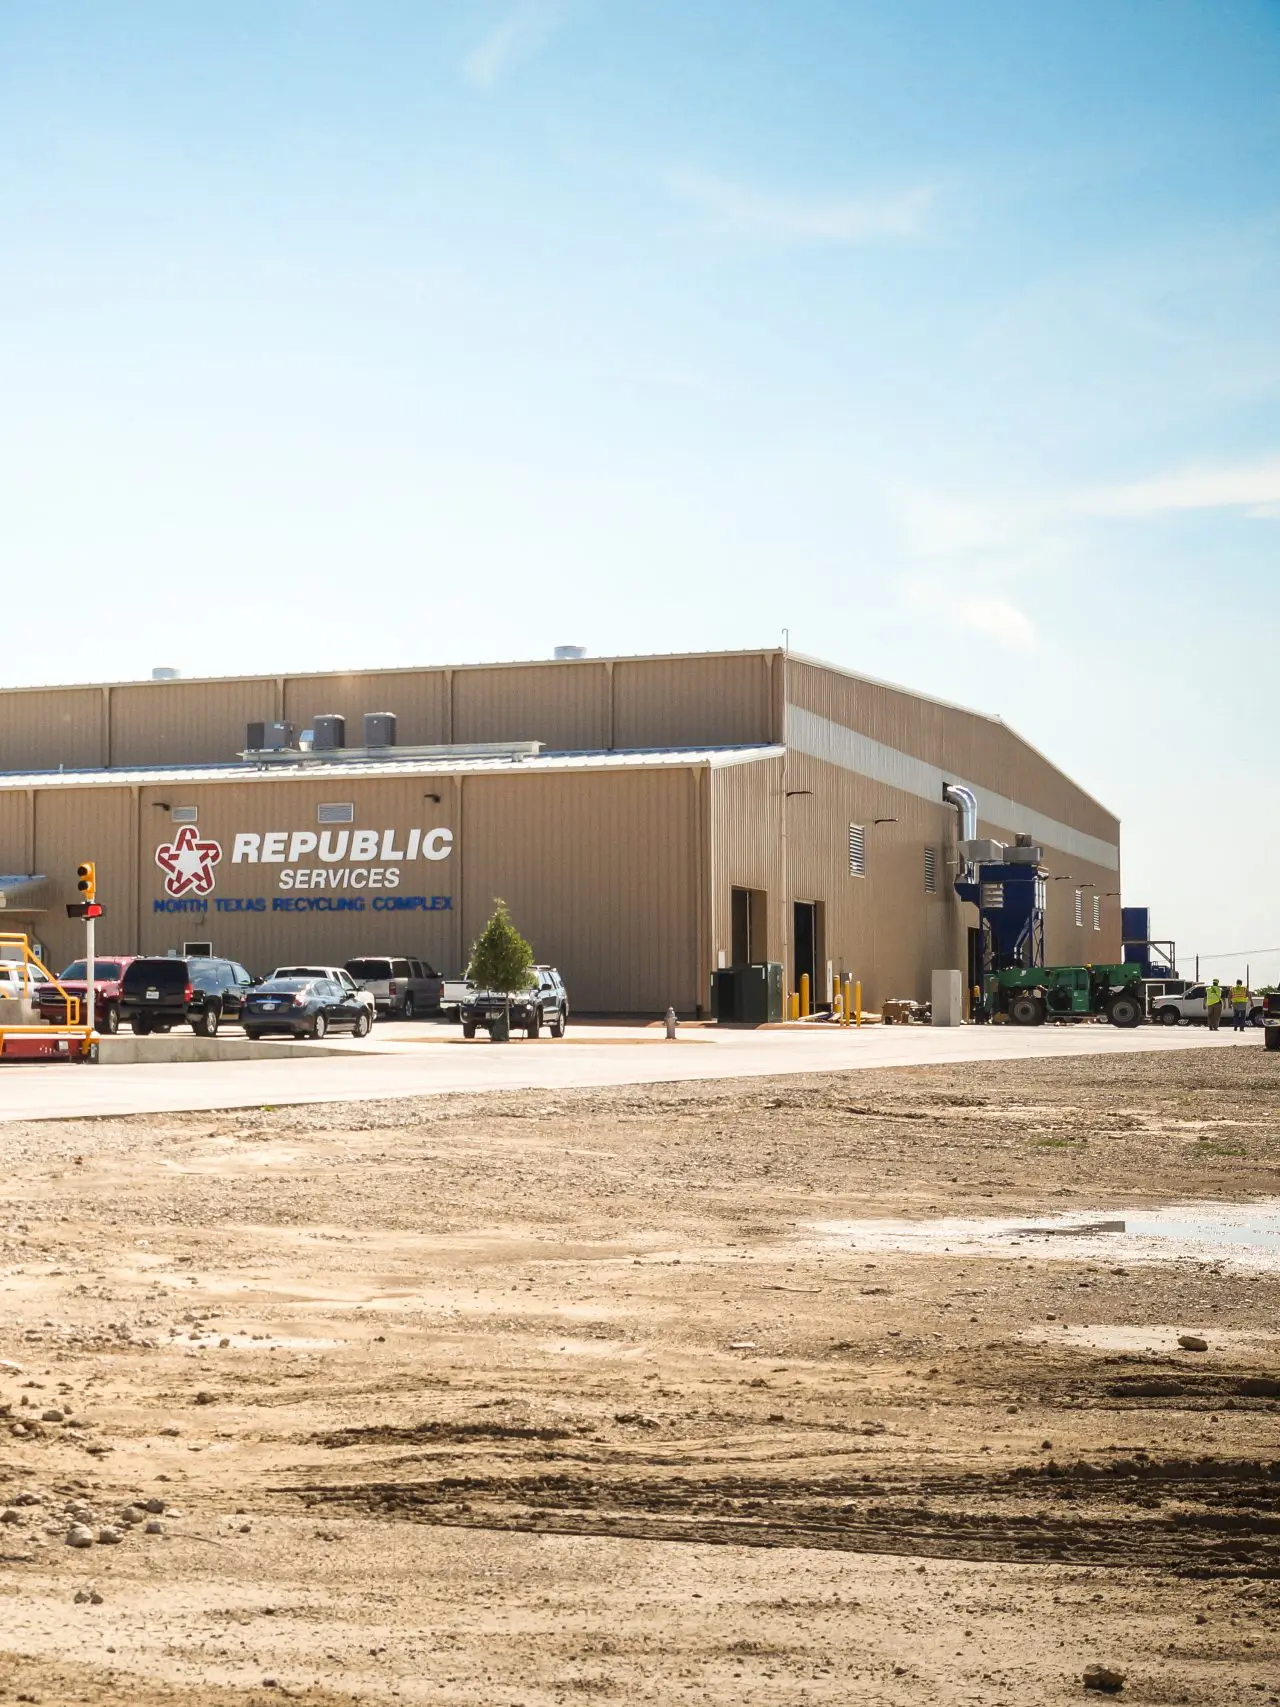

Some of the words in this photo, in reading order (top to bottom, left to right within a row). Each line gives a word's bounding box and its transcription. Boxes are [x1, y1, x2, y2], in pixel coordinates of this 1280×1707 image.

[231, 827, 454, 864] REPUBLIC
[278, 867, 401, 890] SERVICES
[153, 898, 208, 913] NORTH
[214, 898, 266, 912] TEXAS
[272, 897, 365, 912] RECYCLING
[371, 896, 454, 911] COMPLEX
